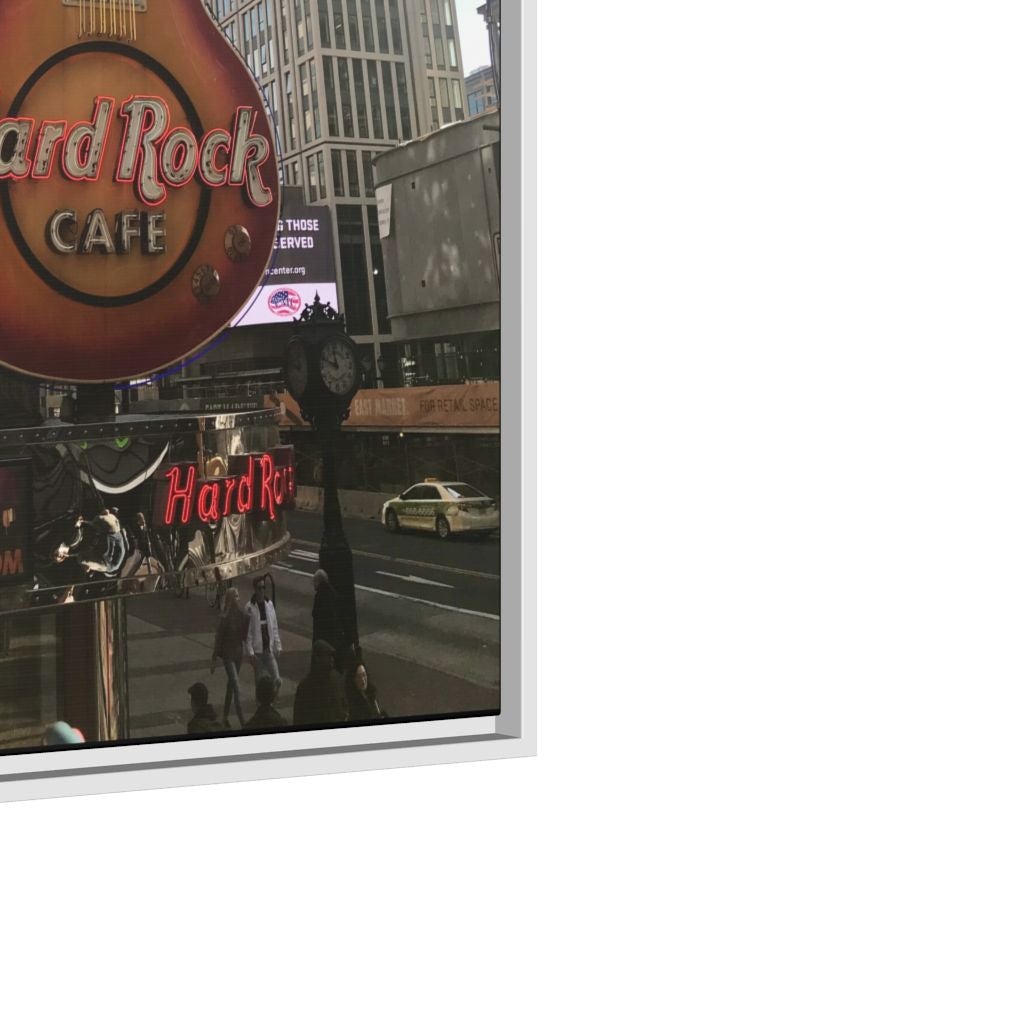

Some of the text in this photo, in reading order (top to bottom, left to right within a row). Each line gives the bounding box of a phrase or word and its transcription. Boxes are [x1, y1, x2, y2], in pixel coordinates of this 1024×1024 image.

[116, 95, 273, 207] Rock
[47, 208, 167, 255] CAFE
[286, 219, 319, 231] THOSE
[419, 399, 435, 413] FOR
[437, 398, 467, 413] RETAIL
[469, 397, 498, 412] SPACE
[164, 453, 294, 525] Hard Ro
